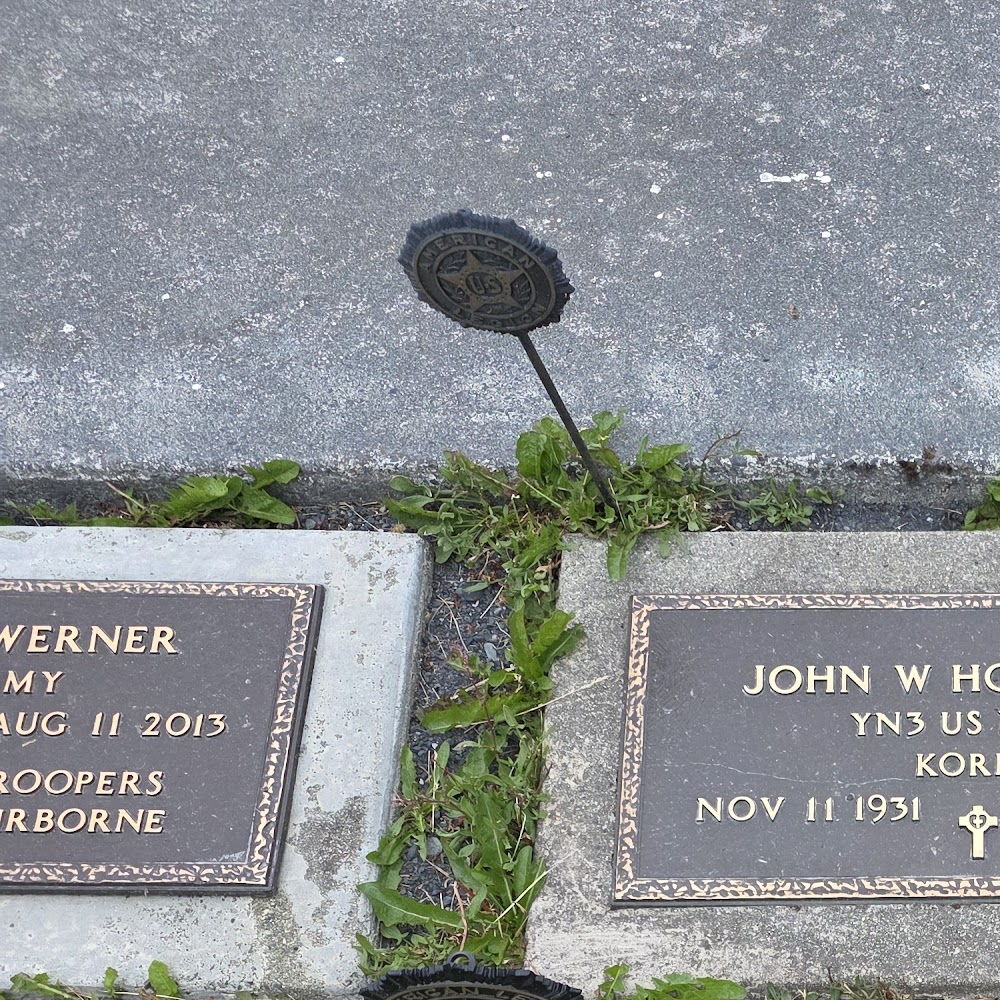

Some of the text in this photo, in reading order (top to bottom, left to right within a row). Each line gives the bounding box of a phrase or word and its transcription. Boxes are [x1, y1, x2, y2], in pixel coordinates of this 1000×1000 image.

[419, 233, 536, 271] AMERICAN
[468, 275, 501, 296] US
[0, 624, 177, 654] WERNER
[741, 663, 870, 696] JOHN
[894, 664, 932, 695] W
[92, 711, 122, 737] 11
[141, 712, 227, 737] 2013
[850, 711, 925, 736] YN3
[941, 711, 981, 735] US
[695, 796, 785, 823] NOV
[806, 797, 834, 822] 11
[855, 796, 921, 822] 1931
